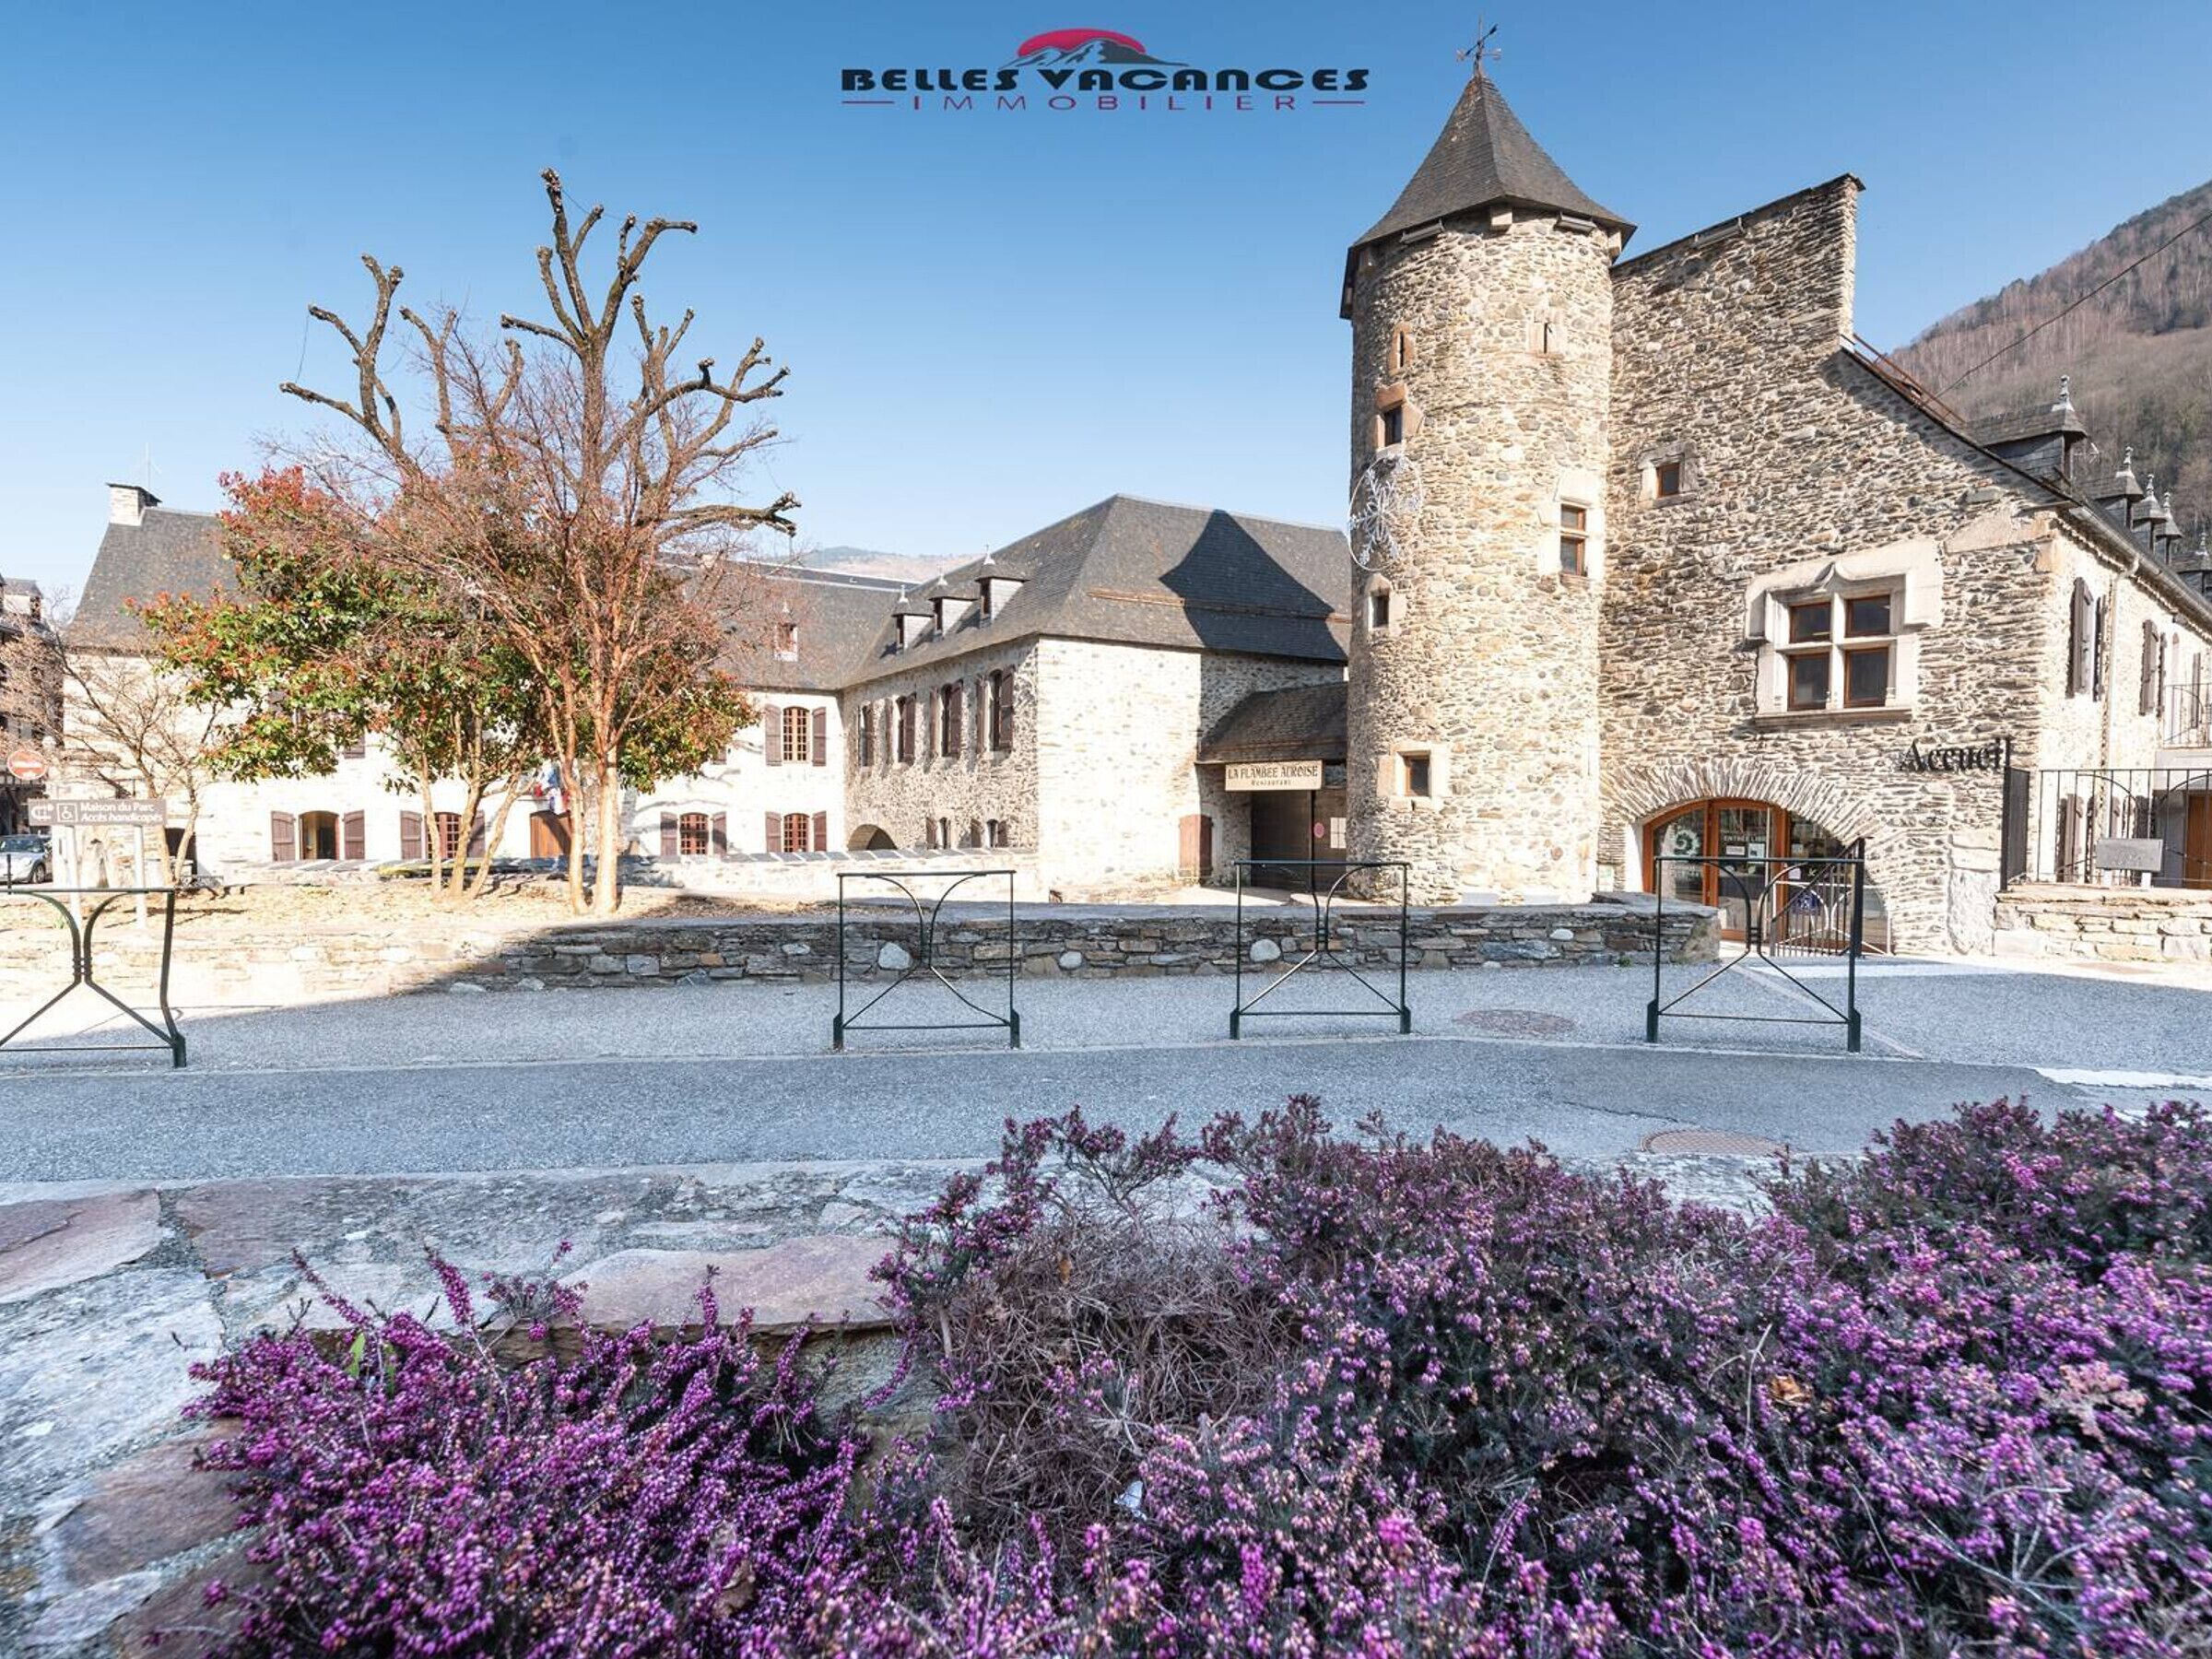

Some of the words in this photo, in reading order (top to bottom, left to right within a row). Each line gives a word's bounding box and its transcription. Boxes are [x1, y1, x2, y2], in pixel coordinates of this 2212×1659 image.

[1900, 736, 2010, 773] Accueil
[1228, 768, 1239, 780] LA
[80, 802, 116, 812] Maison
[118, 801, 132, 812] du
[133, 802, 155, 812] Parc
